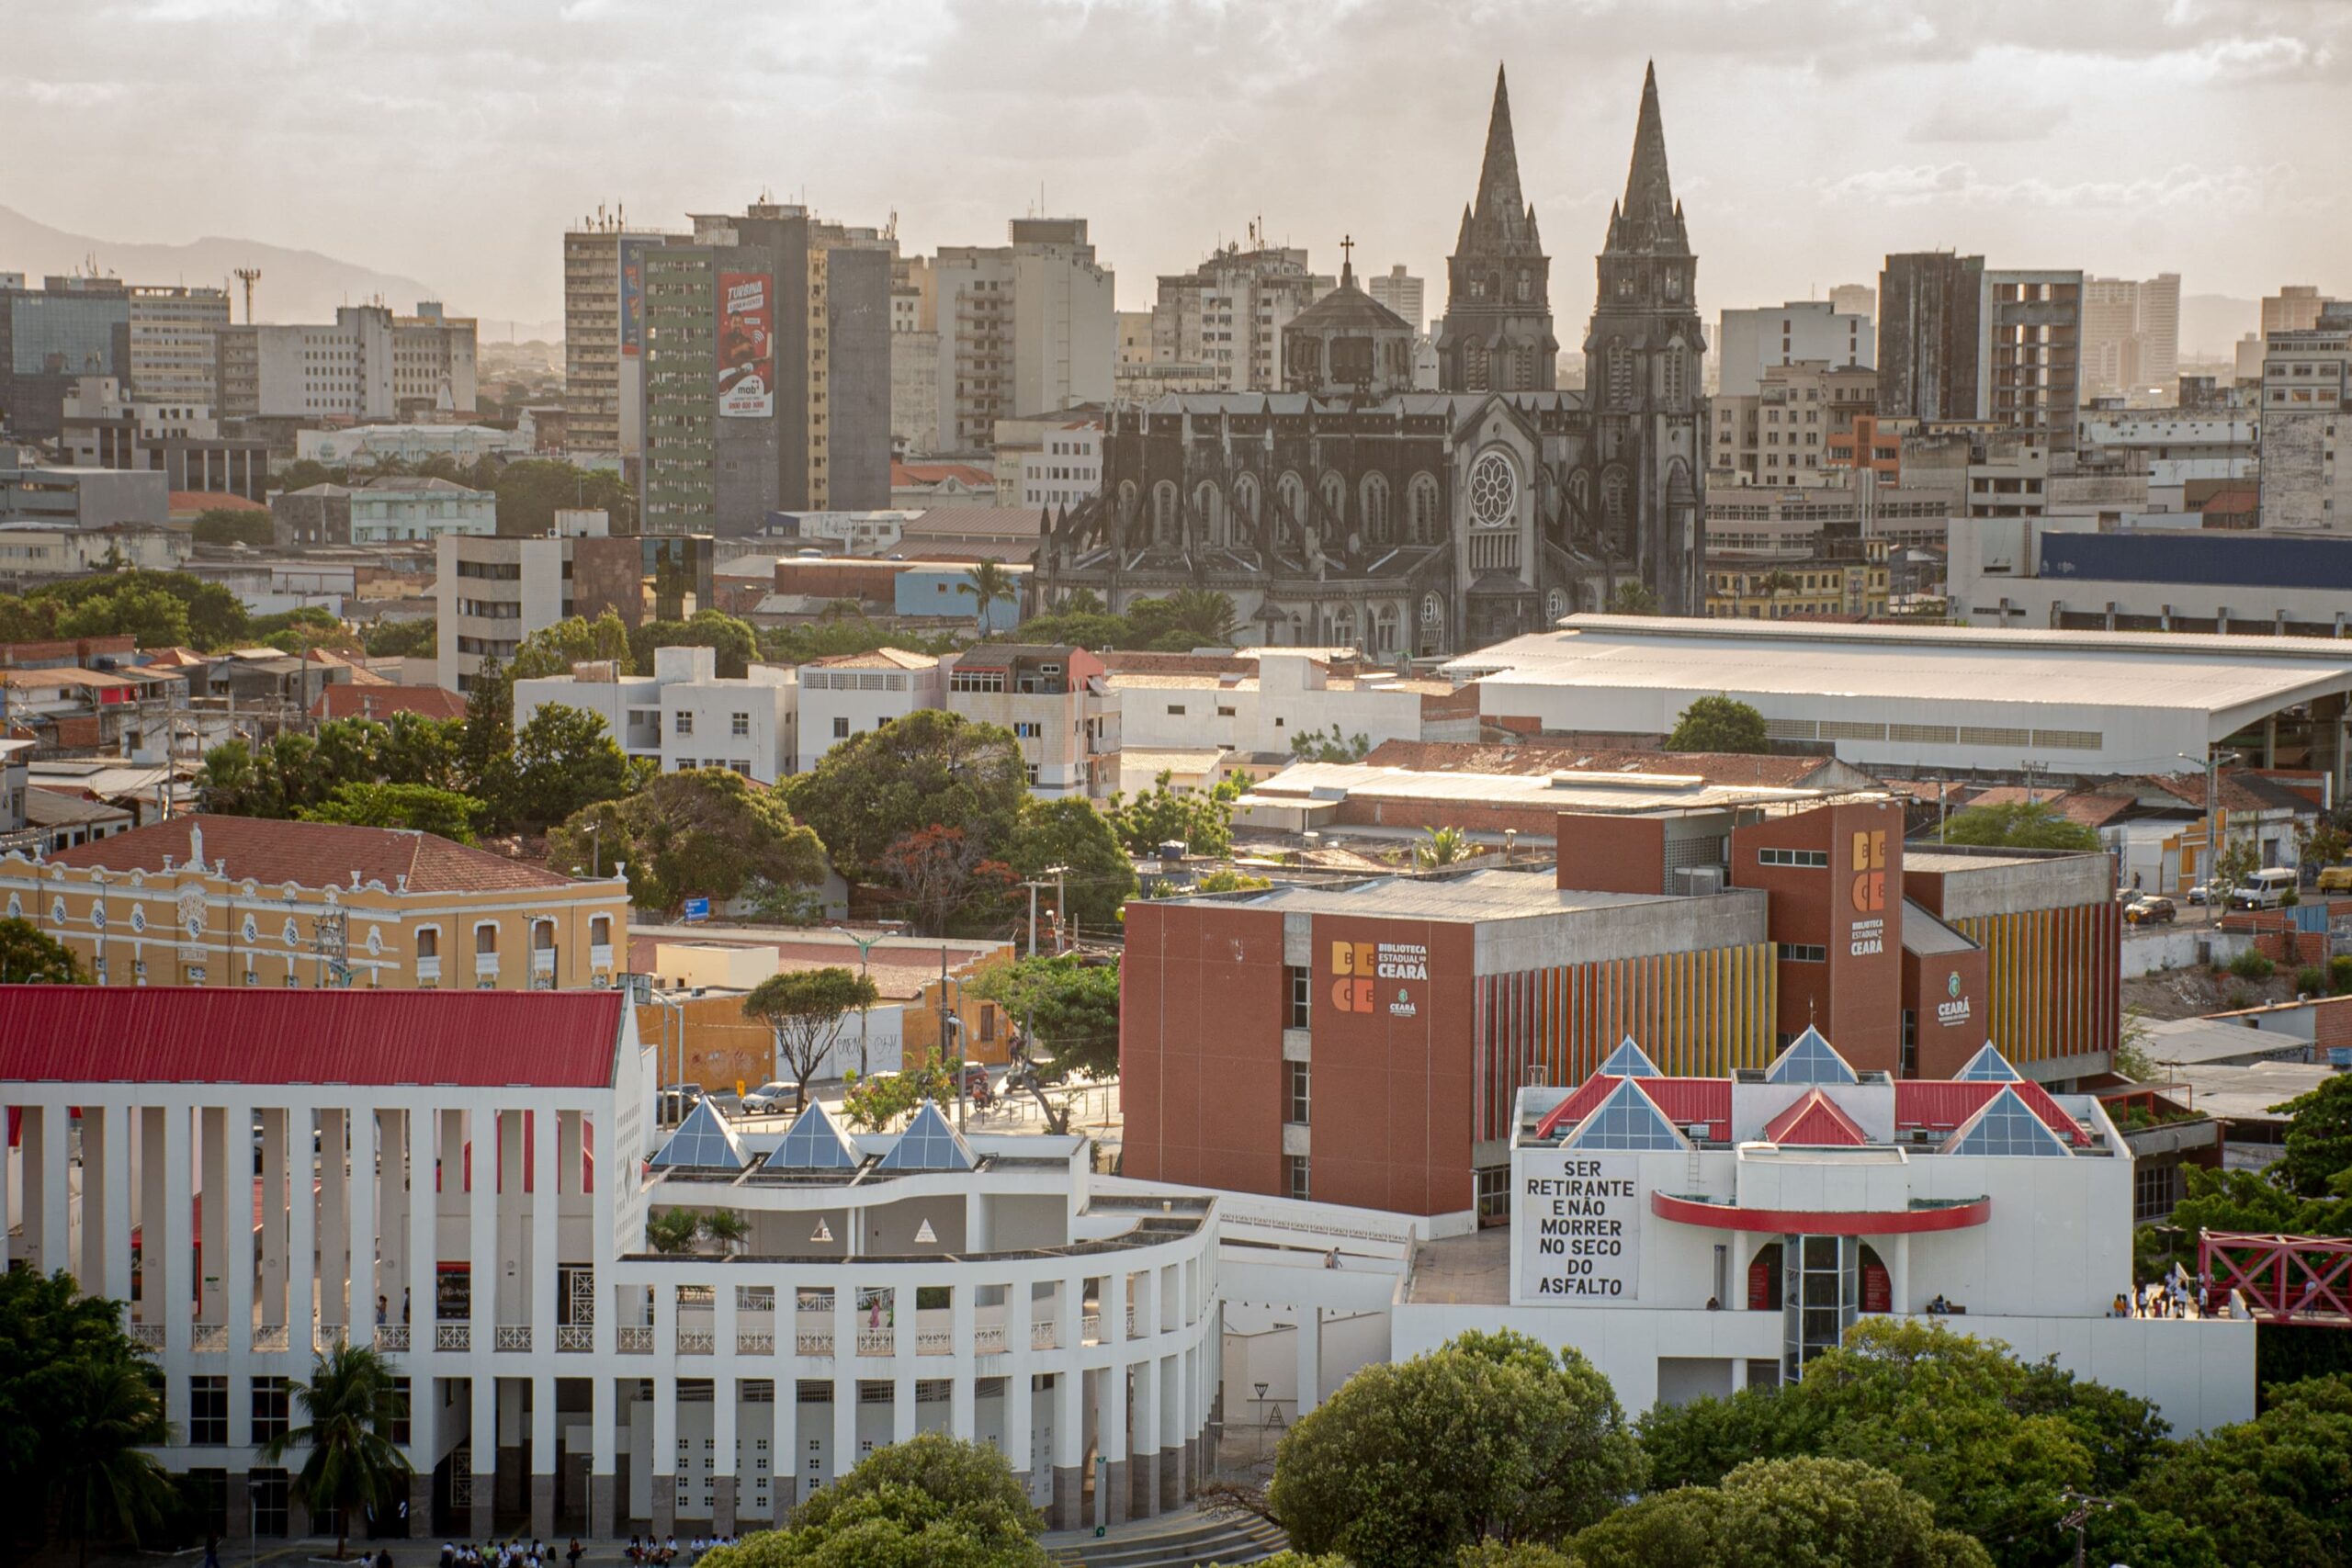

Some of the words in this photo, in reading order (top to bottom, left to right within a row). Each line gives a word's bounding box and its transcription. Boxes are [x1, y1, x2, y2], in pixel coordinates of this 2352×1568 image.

[728, 280, 762, 300] TURBINA
[738, 385, 756, 394] mob
[1852, 919, 1883, 931] BIBLIOTECA
[1852, 929, 1879, 940] ESTADUAL
[1378, 943, 1426, 954] BIBLIOTECA
[1851, 936, 1883, 956] CEARÁ
[1378, 953, 1419, 964] ESTADUAL
[1378, 963, 1427, 980] CEARÁ
[1390, 1003, 1416, 1011] CEARÁ
[1938, 996, 1970, 1016] CEARÁ
[1565, 1161, 1601, 1177] SER
[1527, 1179, 1634, 1197] RETIRANTE
[1553, 1200, 1564, 1215] E
[1568, 1197, 1605, 1216] NÃO
[1541, 1219, 1622, 1236] MORRER
[1540, 1238, 1564, 1254] NO
[1571, 1239, 1621, 1256] SECO
[1567, 1259, 1593, 1275] DO
[1539, 1277, 1622, 1295] ASFALTO
